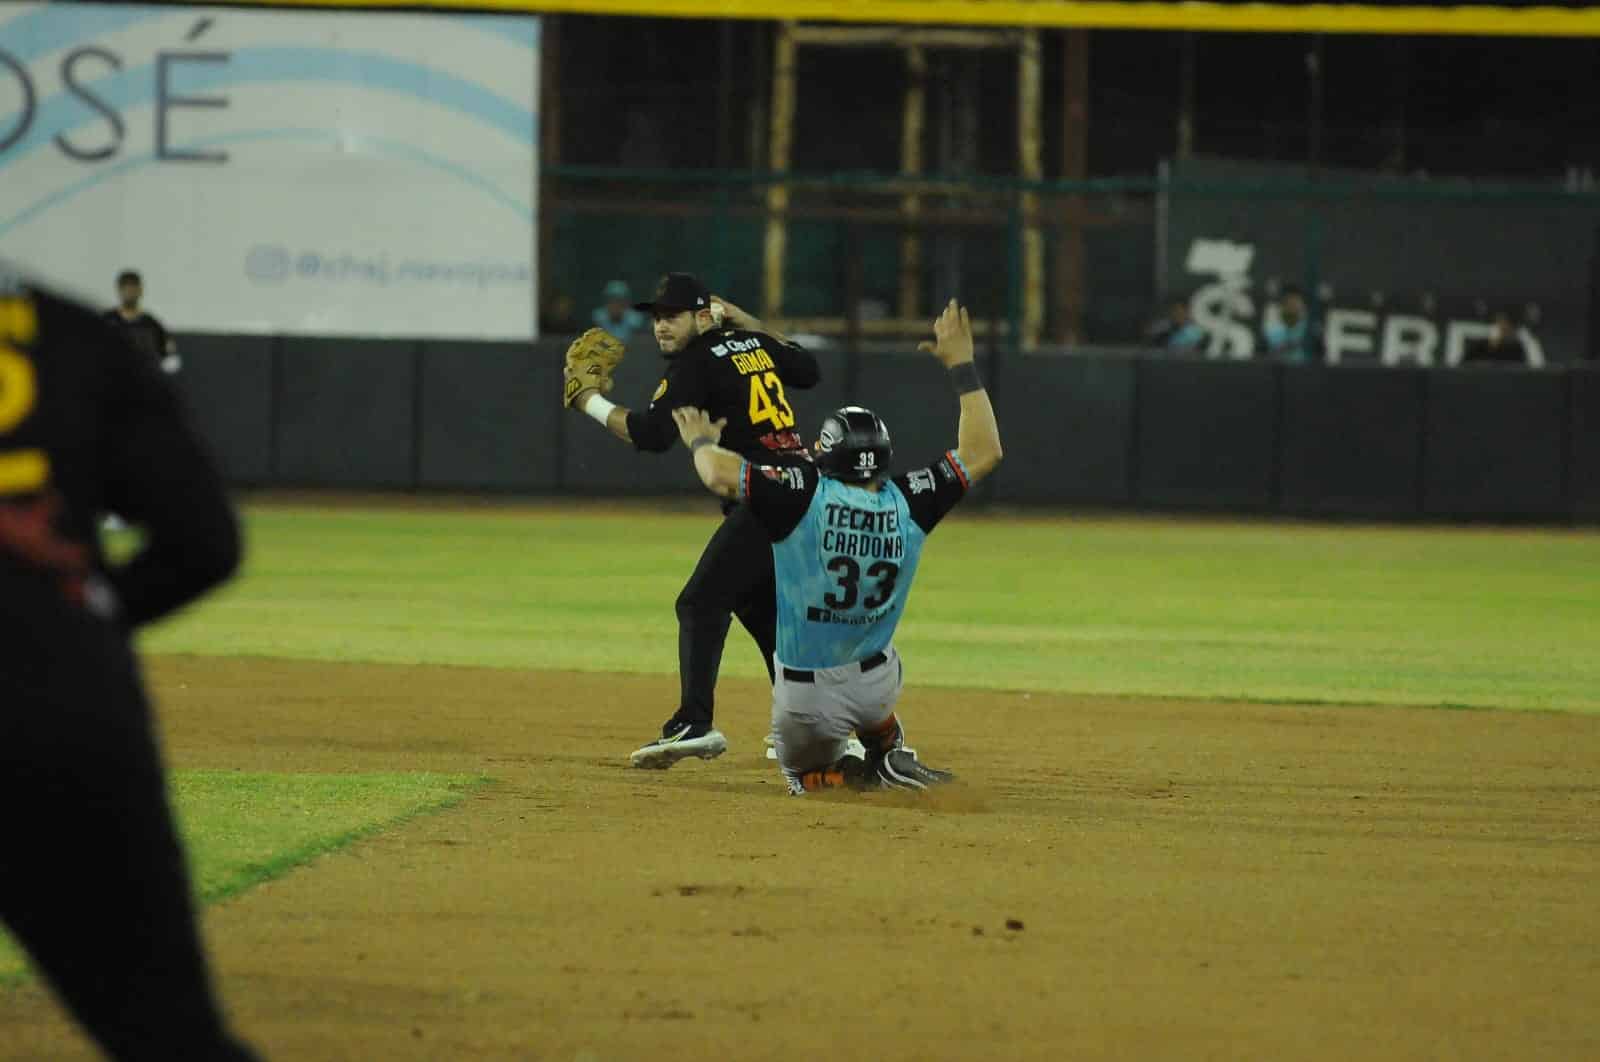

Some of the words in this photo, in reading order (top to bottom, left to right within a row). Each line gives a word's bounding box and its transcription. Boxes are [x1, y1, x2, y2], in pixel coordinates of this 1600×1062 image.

[749, 371, 795, 430] 43
[825, 504, 897, 532] TECATE
[823, 530, 903, 559] CARDONA
[823, 556, 899, 610] 33
